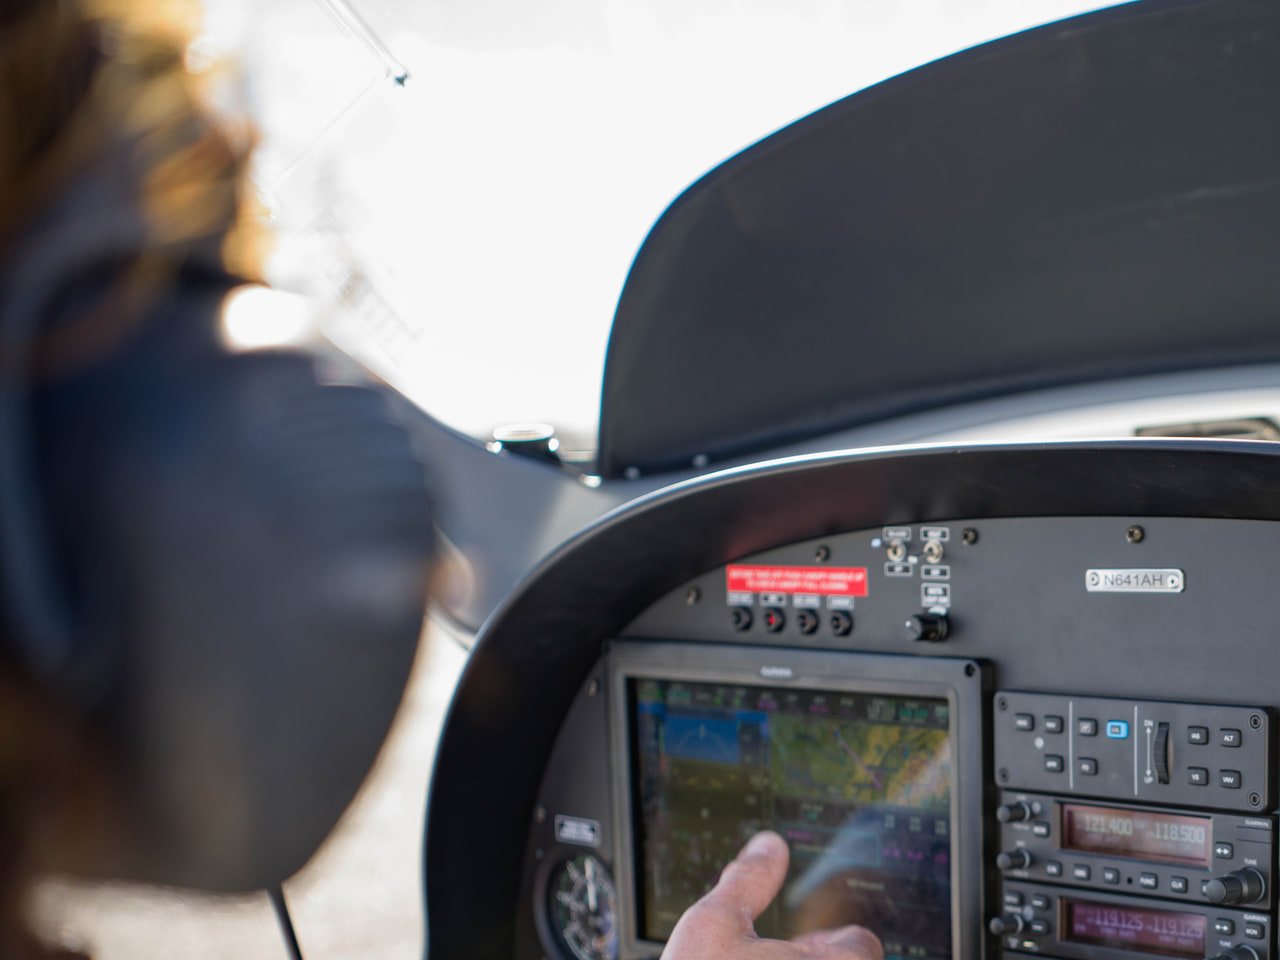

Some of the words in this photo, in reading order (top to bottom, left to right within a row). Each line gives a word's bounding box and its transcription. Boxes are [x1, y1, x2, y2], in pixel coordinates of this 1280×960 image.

[1105, 574, 1162, 586] N641AH
[1223, 776, 1234, 784] VNV
[1245, 819, 1269, 827] GARMIN
[1155, 823, 1205, 844] 118.500
[1140, 877, 1155, 886] FUNC
[1172, 880, 1183, 889] CLR
[1244, 914, 1268, 922] GARMIN
